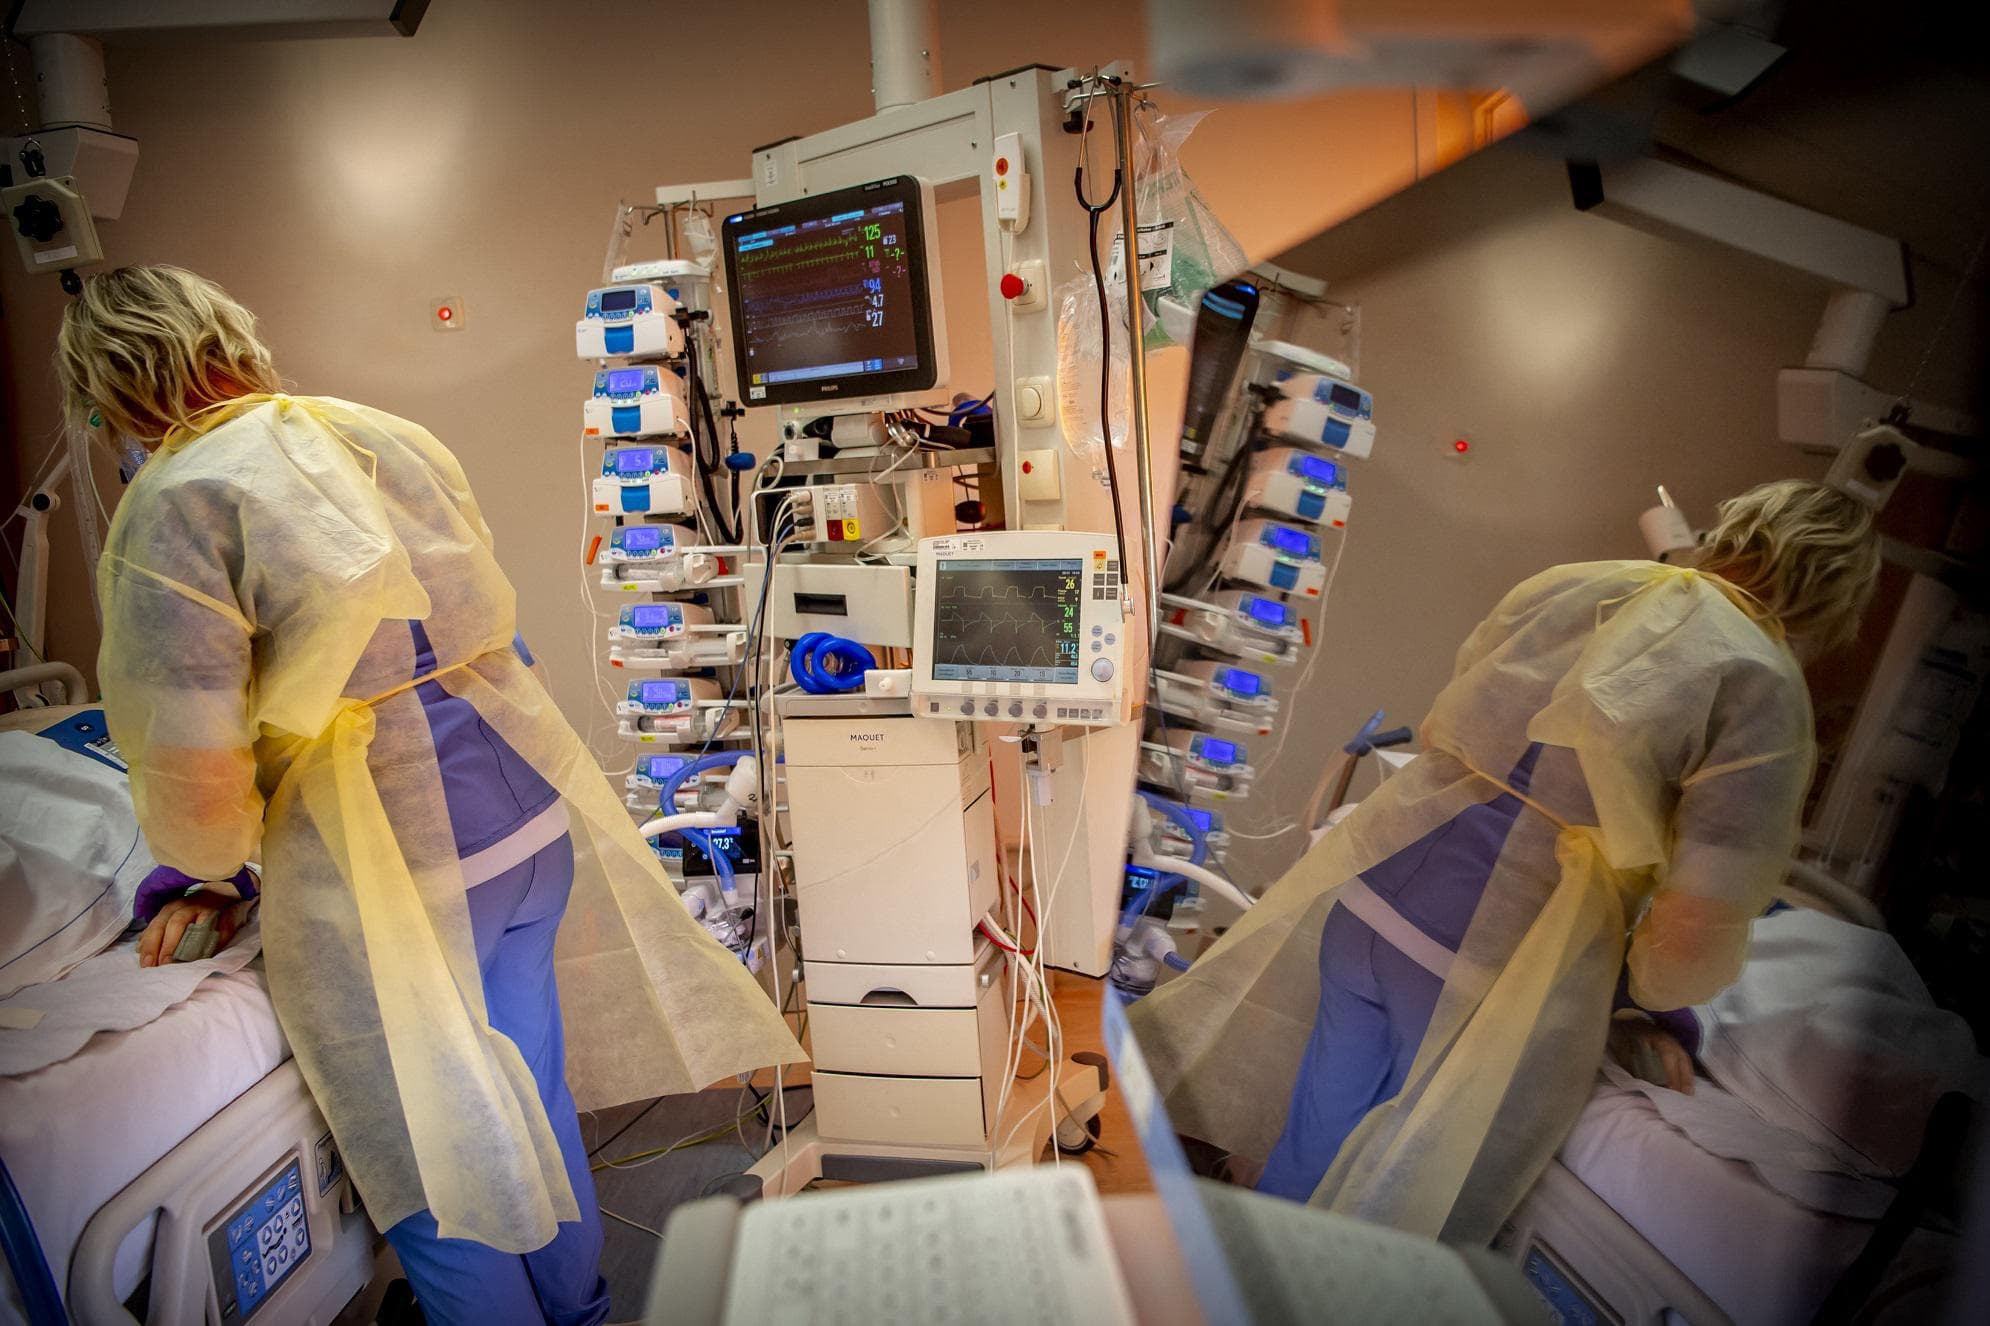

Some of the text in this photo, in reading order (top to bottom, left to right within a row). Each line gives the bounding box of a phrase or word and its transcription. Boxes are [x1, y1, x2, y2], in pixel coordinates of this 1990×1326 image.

[864, 223, 881, 241] 125
[865, 245, 874, 259] 11
[871, 310, 884, 327] 27
[1065, 579, 1075, 590] 26
[1064, 607, 1074, 618] 24
[1063, 622, 1073, 633] 55
[1060, 643, 1077, 654] 11.2
[850, 734, 885, 742] MAQUET
